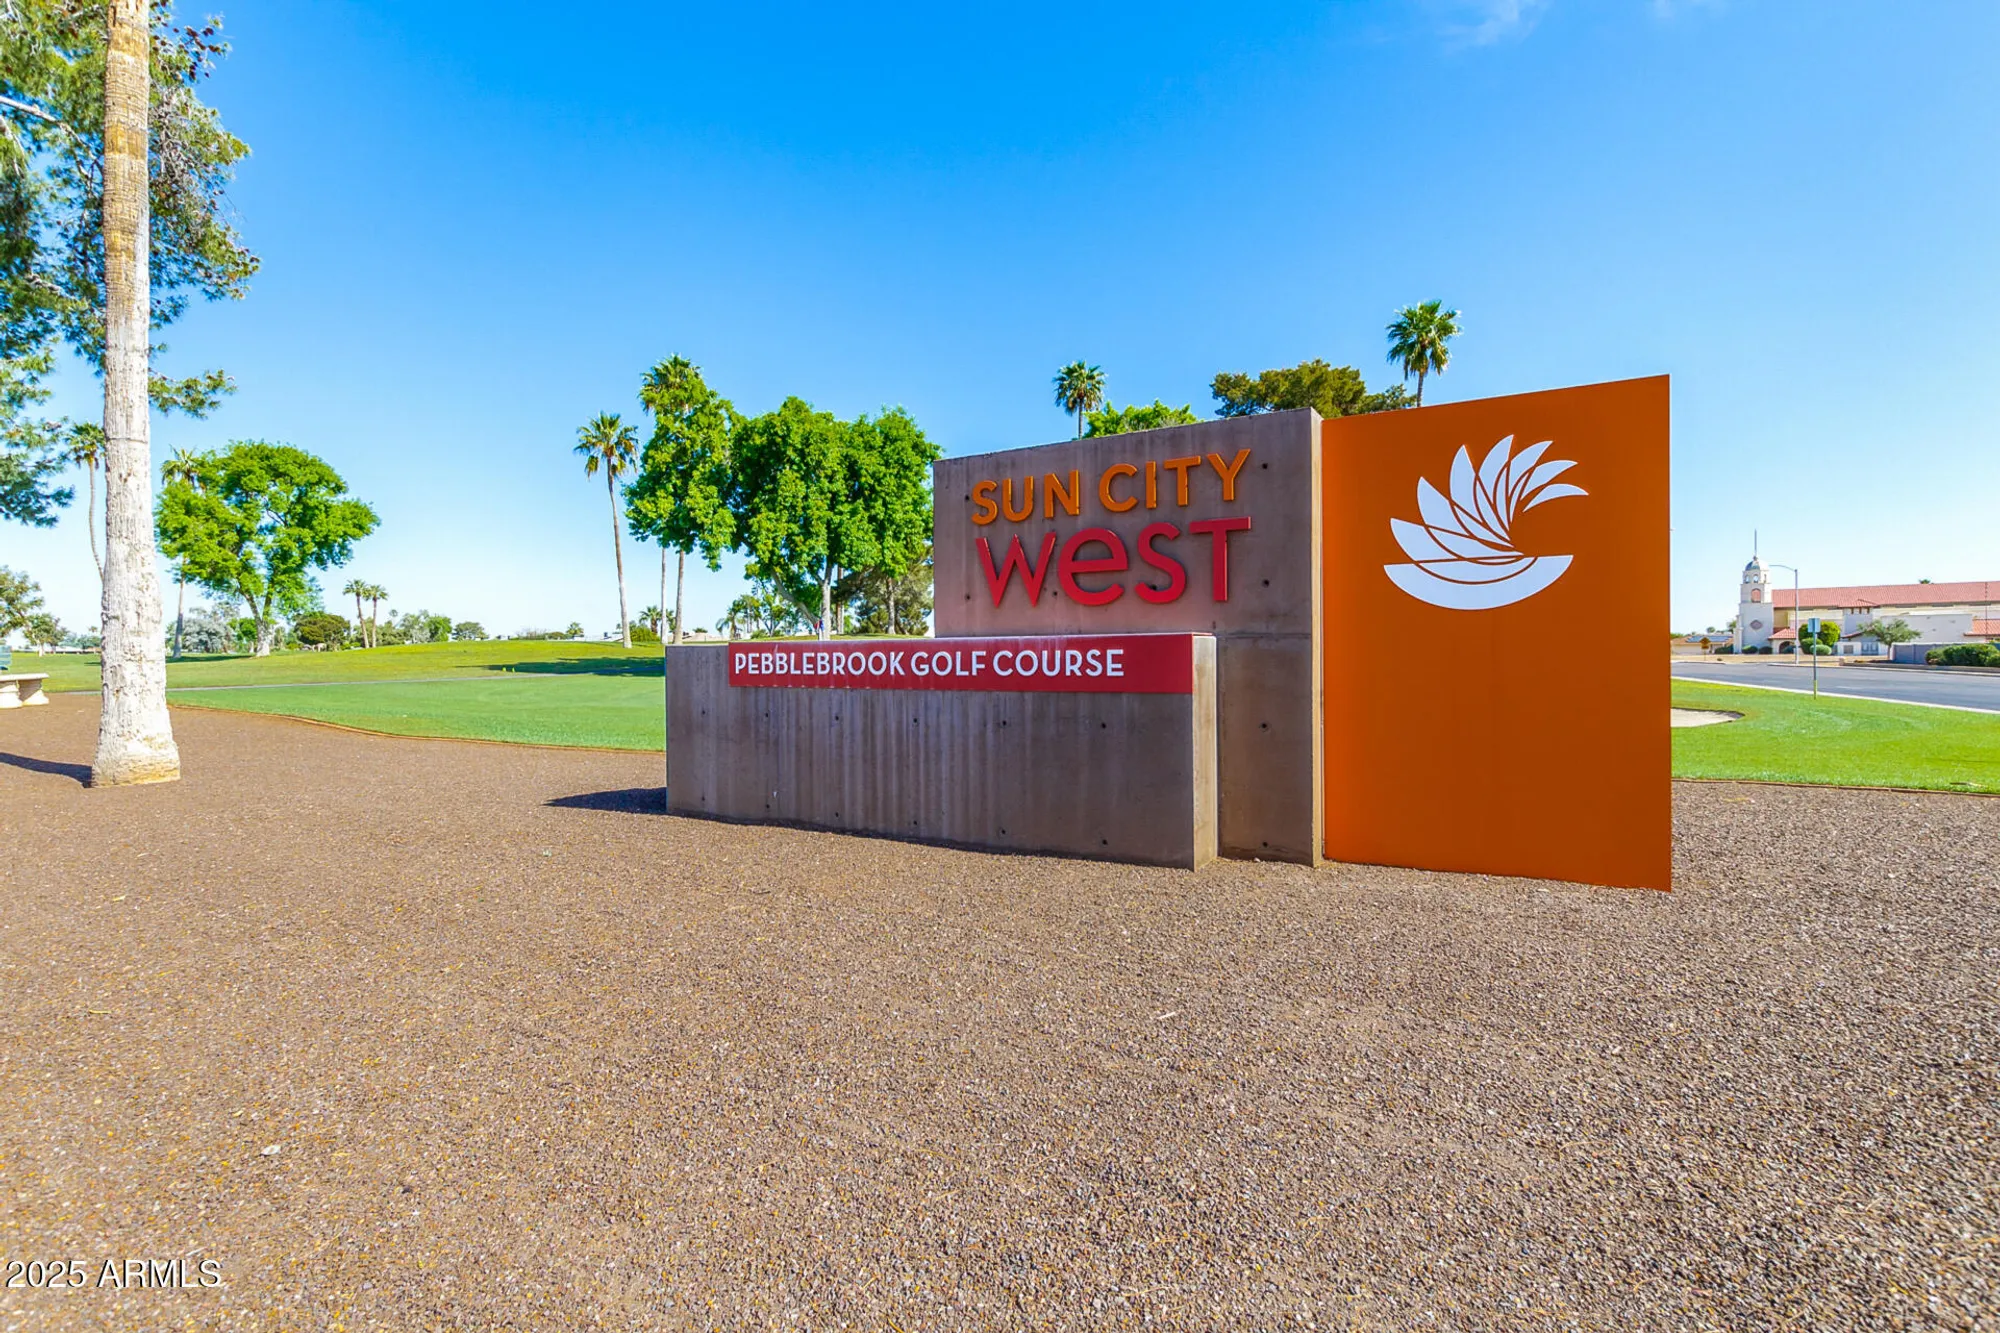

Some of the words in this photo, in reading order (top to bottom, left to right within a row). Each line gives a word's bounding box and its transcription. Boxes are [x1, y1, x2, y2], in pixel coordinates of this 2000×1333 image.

[971, 469, 1080, 526] SUN
[1099, 448, 1251, 513] CITY
[734, 651, 906, 676] PEBBLEBROOK
[911, 650, 987, 677] GOLF
[992, 649, 1124, 677] COURSE
